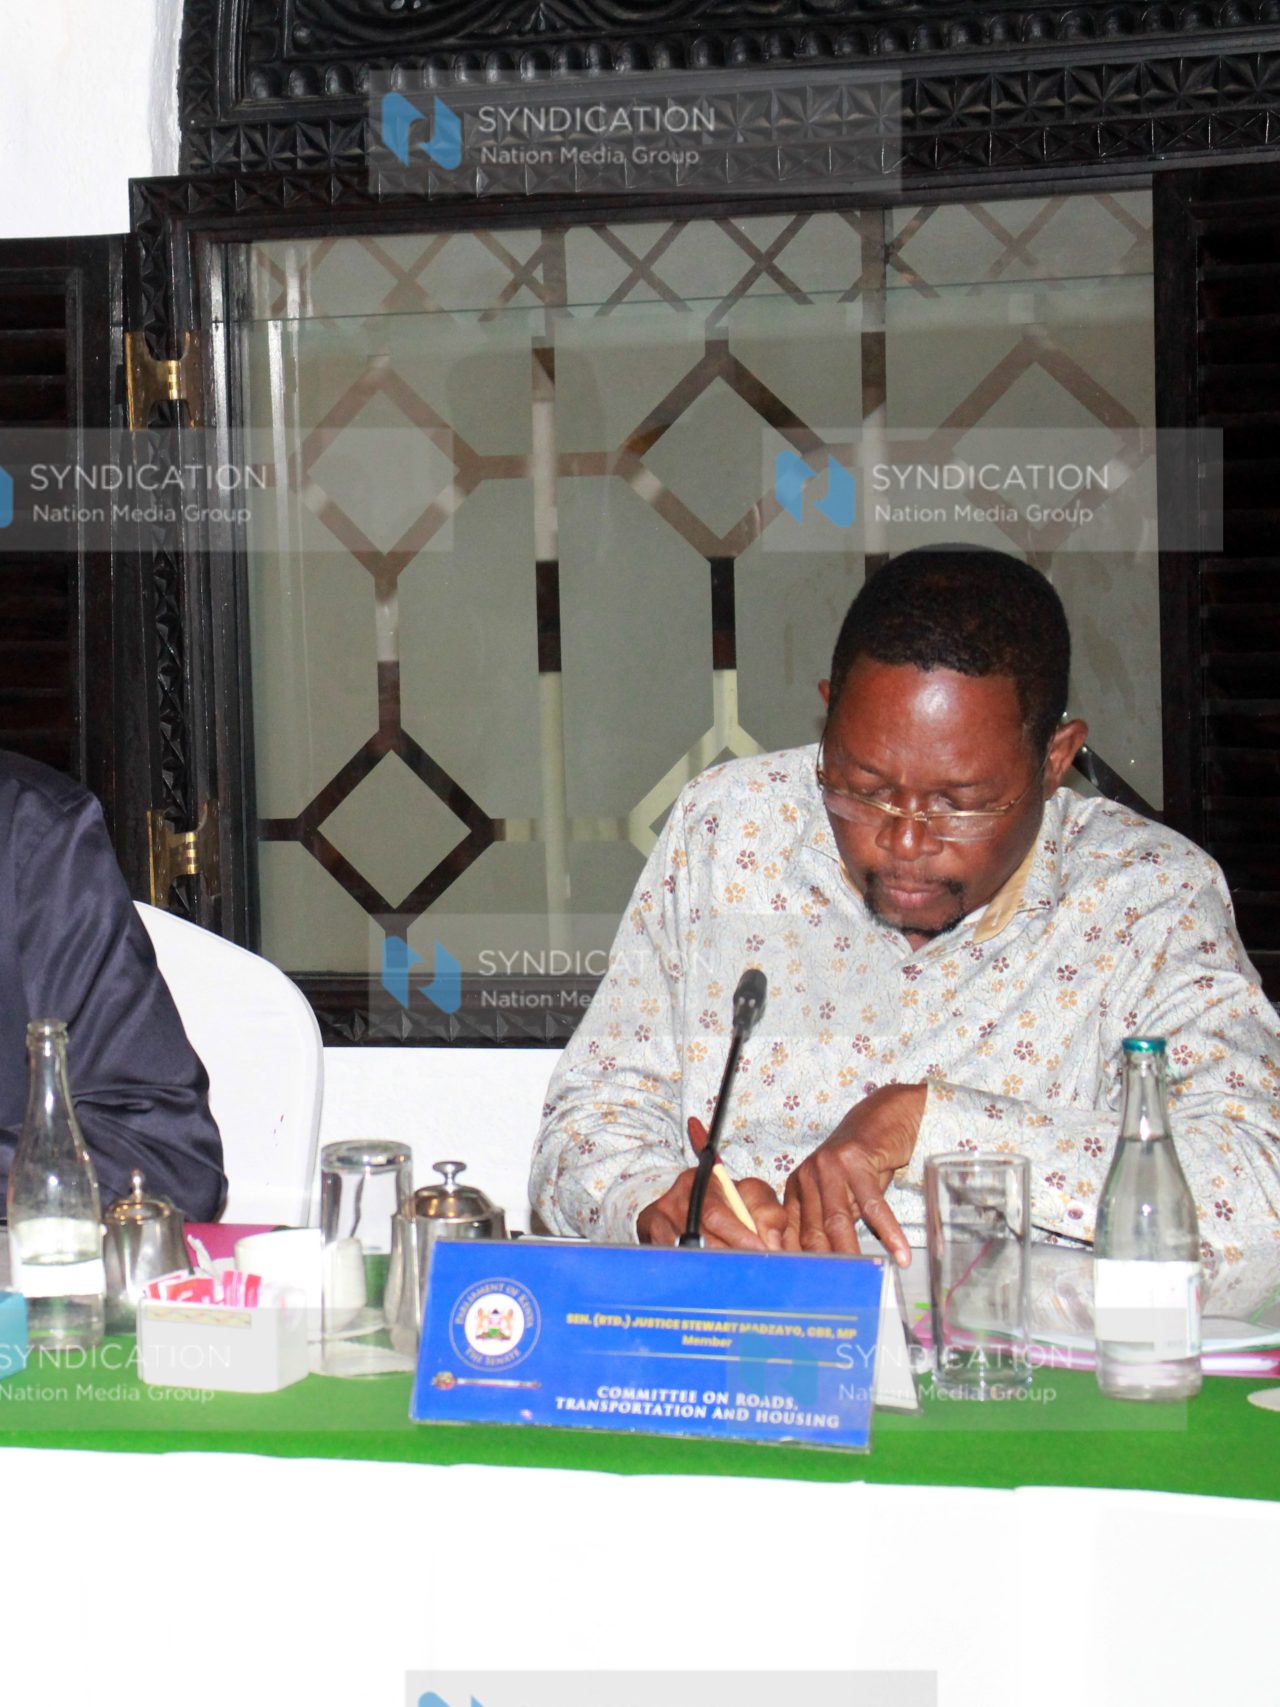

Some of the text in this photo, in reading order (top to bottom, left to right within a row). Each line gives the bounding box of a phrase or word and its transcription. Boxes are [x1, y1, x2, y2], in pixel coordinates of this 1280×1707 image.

[566, 1313, 592, 1325] SEN.
[632, 1316, 681, 1330] JUSTICE
[682, 1319, 738, 1332] STEWART
[682, 1334, 732, 1348] Member
[597, 1385, 698, 1404] COMMITTEE
[703, 1391, 730, 1406] ON
[556, 1396, 840, 1429] TRANSPORTATION AND HOUSING
